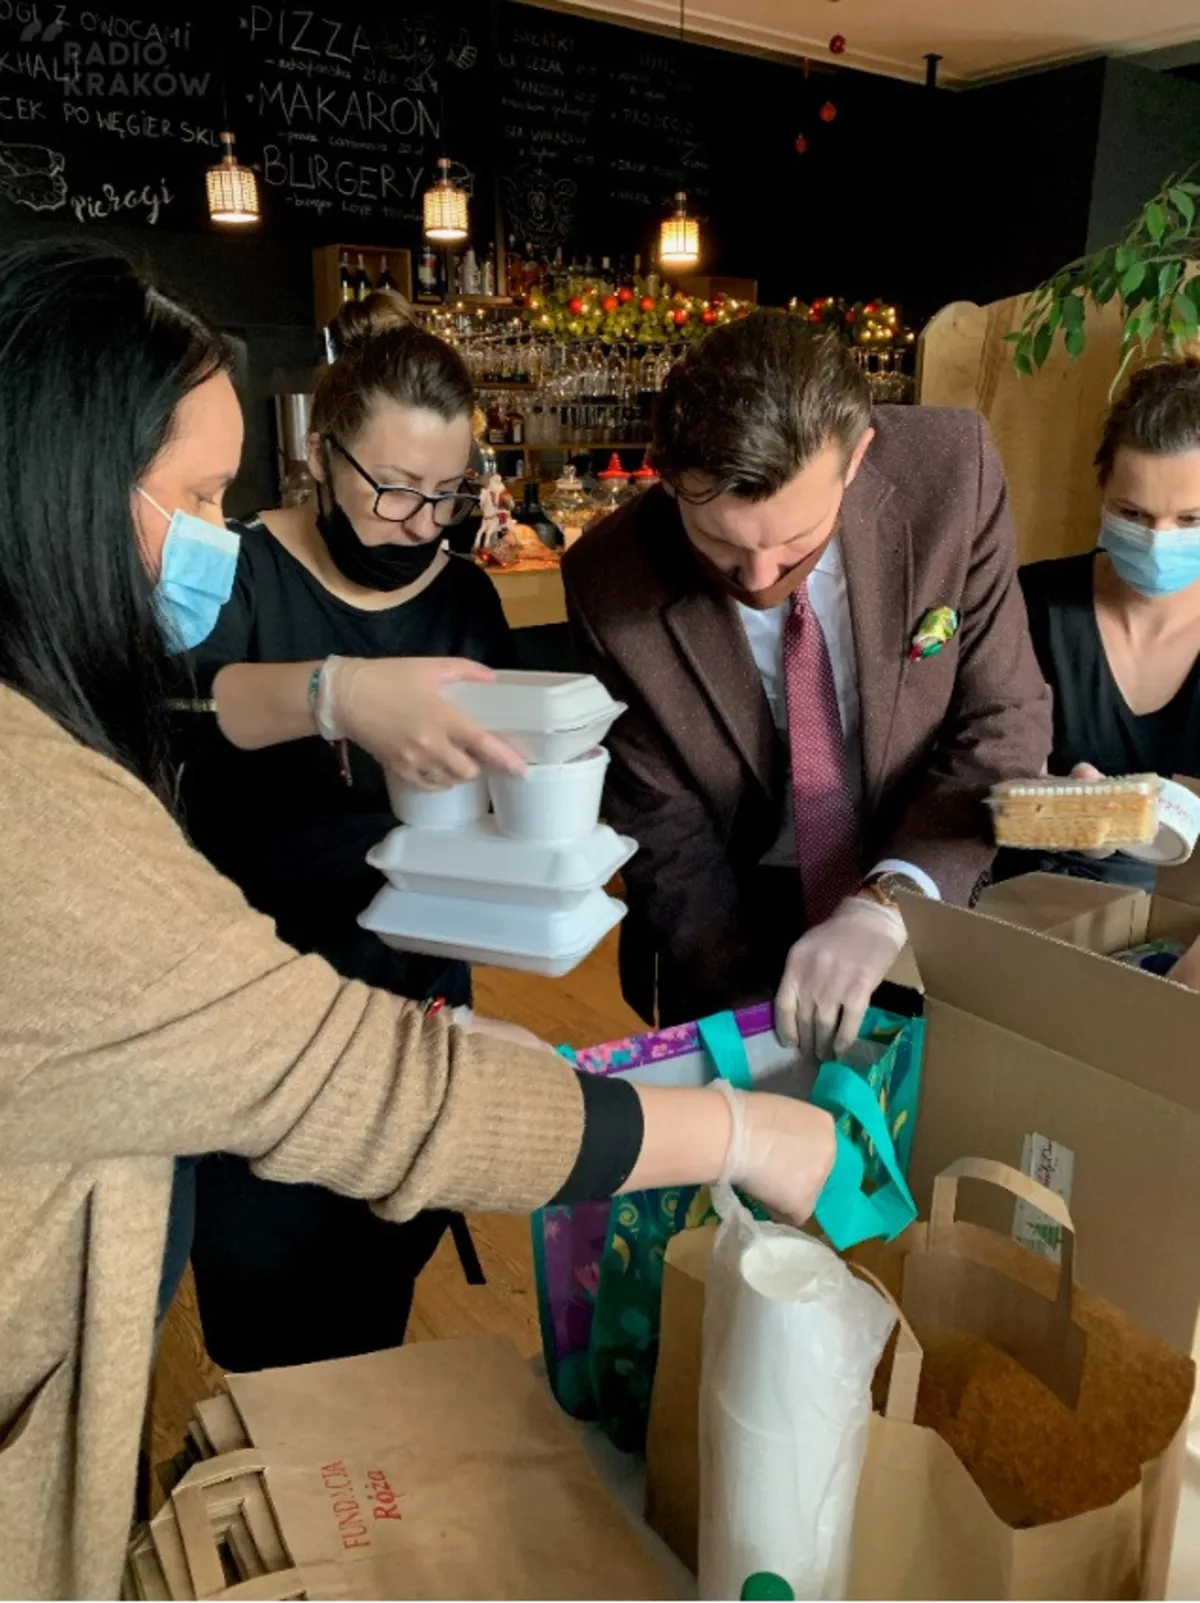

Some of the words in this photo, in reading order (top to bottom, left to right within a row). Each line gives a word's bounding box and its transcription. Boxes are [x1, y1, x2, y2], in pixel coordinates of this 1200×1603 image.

[53, 4, 72, 27] Z
[249, 5, 376, 66] PIZZA
[62, 101, 89, 124] PO
[259, 80, 441, 140] MAKARON
[263, 144, 424, 200] BURGERY
